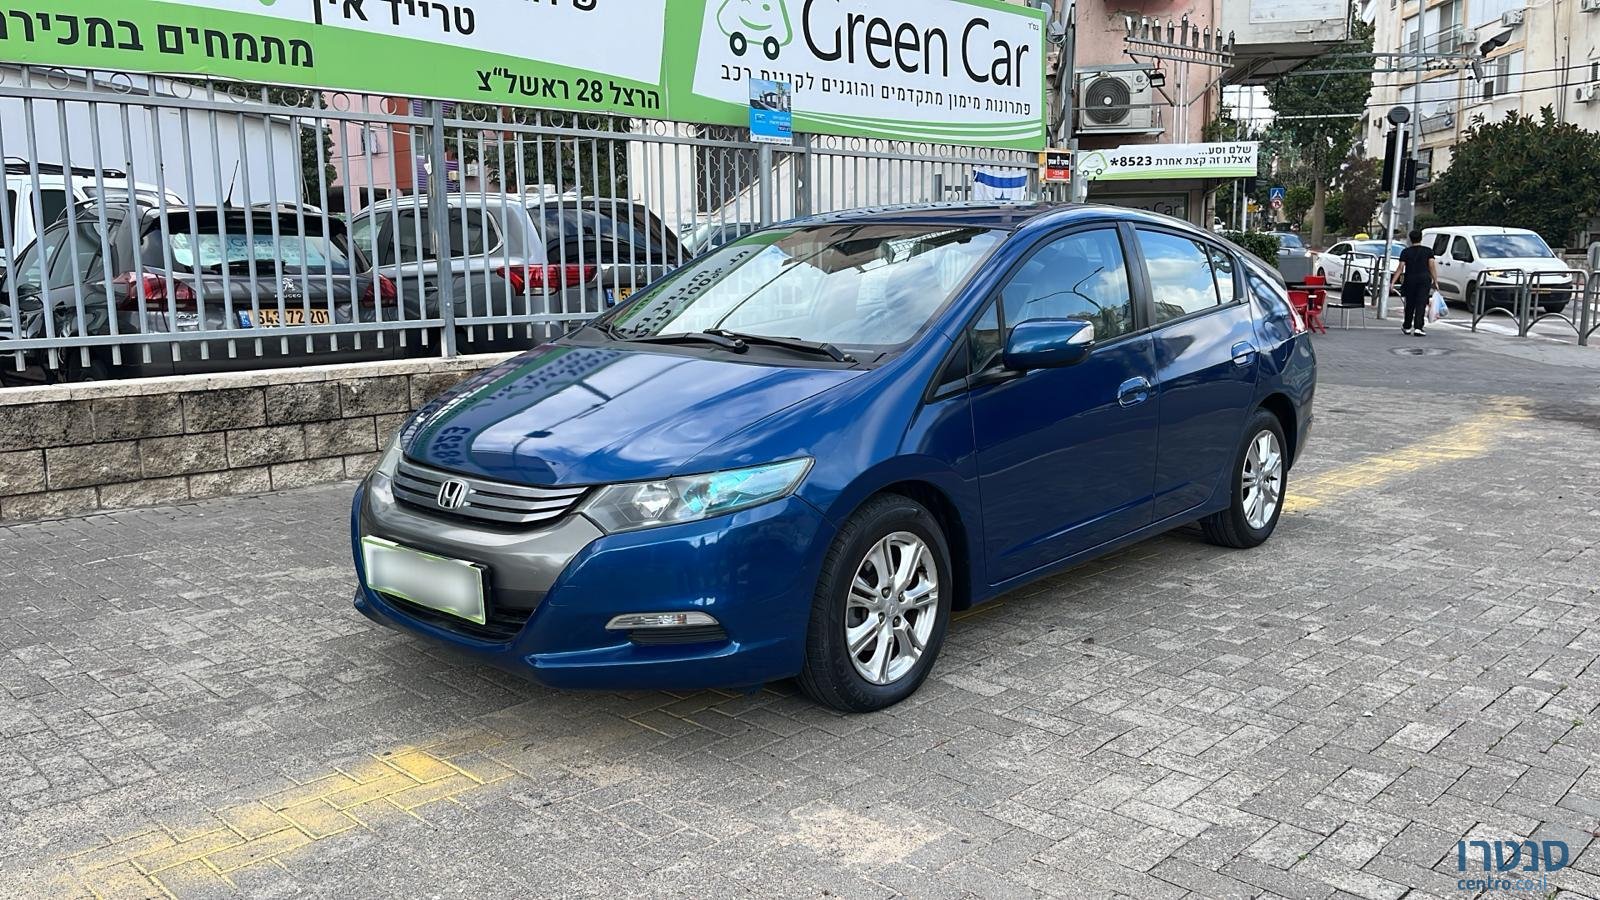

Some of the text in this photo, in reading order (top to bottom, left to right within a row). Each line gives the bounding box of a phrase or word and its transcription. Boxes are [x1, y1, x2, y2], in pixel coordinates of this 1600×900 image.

[0, 9, 314, 68] מתמחים במכיר
[802, 0, 1030, 88] Green Car
[576, 78, 604, 103] 28
[609, 81, 660, 110] הרצל
[822, 77, 876, 98] והוגנים
[881, 85, 944, 107] מתקדמים
[948, 93, 981, 110] מימון
[985, 98, 1032, 116] פתרונות
[1229, 145, 1252, 154] שלם
[1155, 158, 1182, 166] אחרת
[1185, 157, 1206, 167] קצת
[1223, 155, 1251, 164] אצלנו
